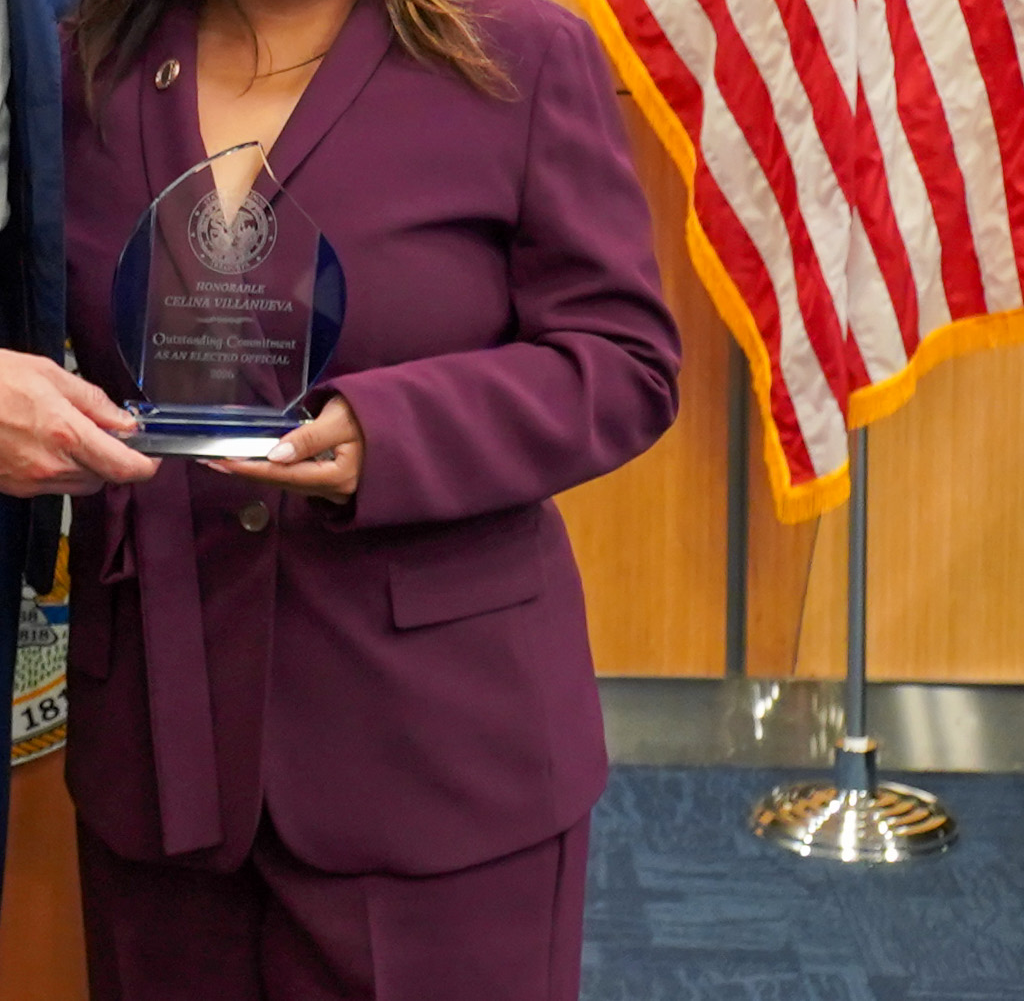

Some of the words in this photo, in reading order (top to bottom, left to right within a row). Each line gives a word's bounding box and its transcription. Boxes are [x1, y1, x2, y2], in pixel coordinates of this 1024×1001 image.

[195, 281, 266, 294] HONORABLE
[164, 296, 211, 309] CELINA
[213, 297, 294, 312] VILLANUEVA
[152, 332, 224, 350] Outstanding
[226, 335, 296, 349] Commitment
[154, 350, 171, 360] AS
[171, 351, 188, 361] AN
[189, 351, 239, 363] ELECTED
[239, 353, 290, 366] OFFICIAL
